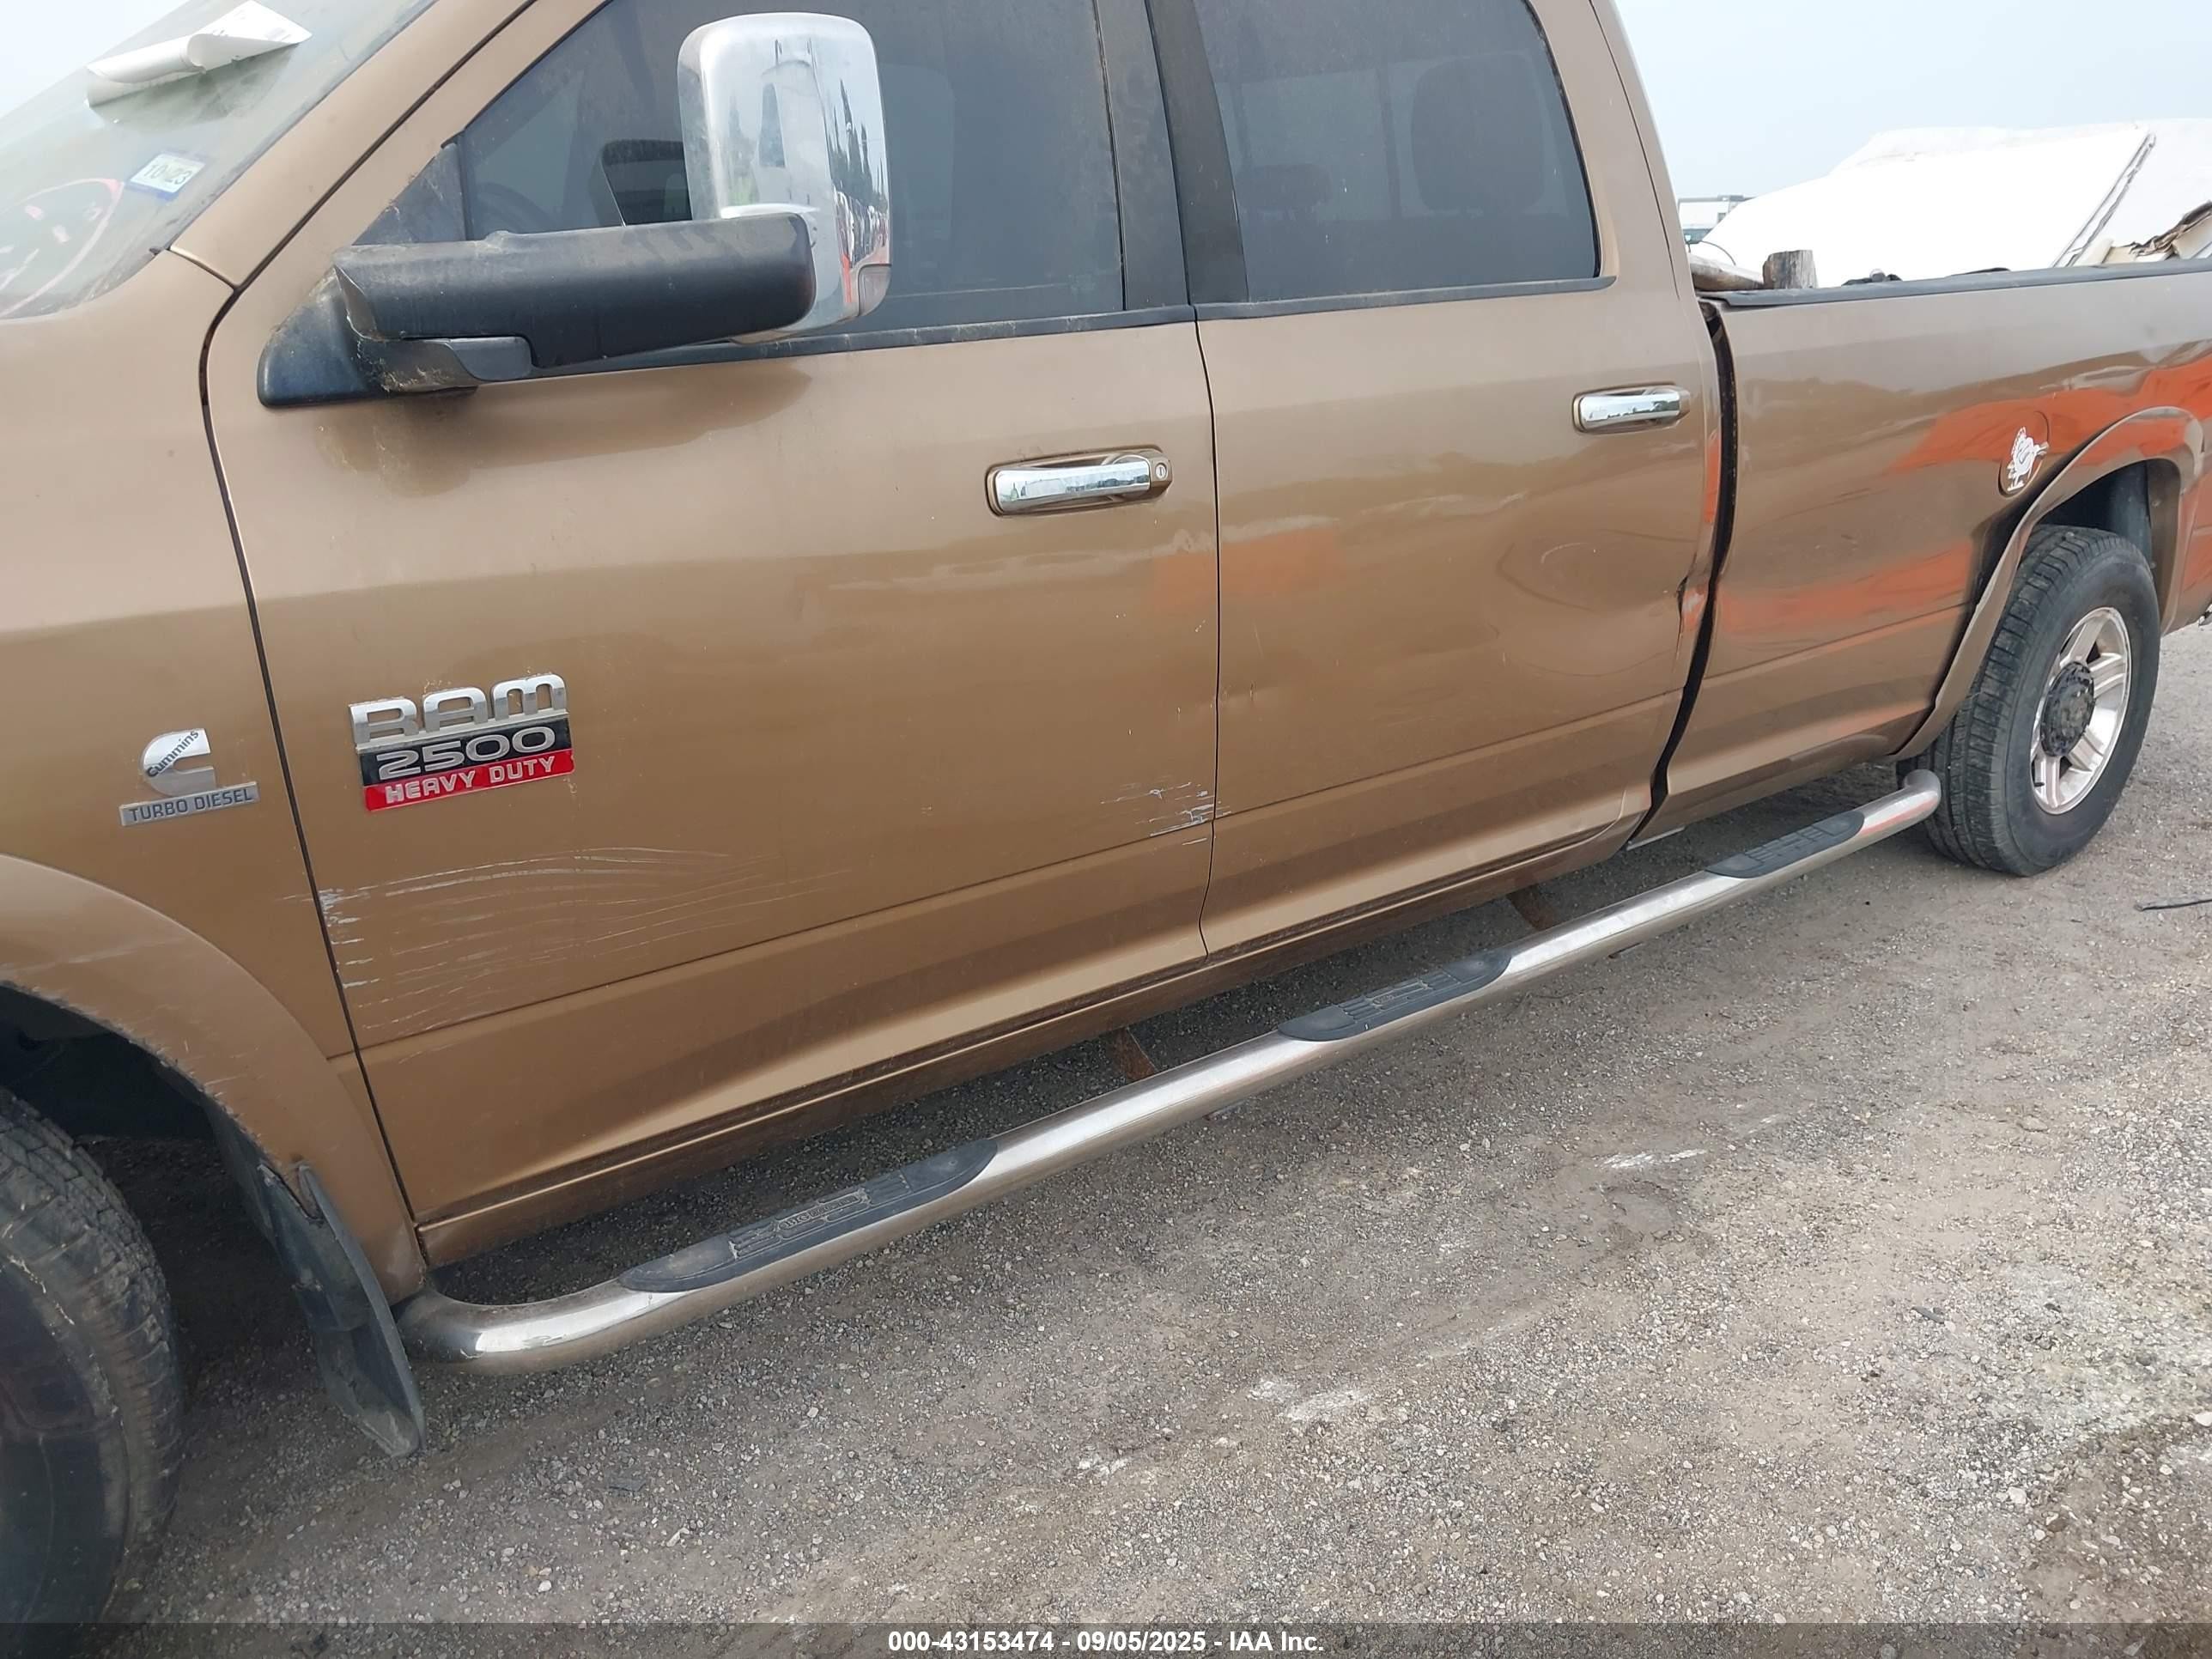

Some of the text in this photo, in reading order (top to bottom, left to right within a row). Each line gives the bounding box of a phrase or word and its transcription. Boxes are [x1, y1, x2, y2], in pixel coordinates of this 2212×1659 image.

[349, 672, 568, 744] RAM
[146, 729, 200, 778] Cummins
[376, 726, 556, 781] 2500
[129, 788, 253, 822] TURBO DIESEL
[384, 755, 556, 805] HEAVY DUTY
